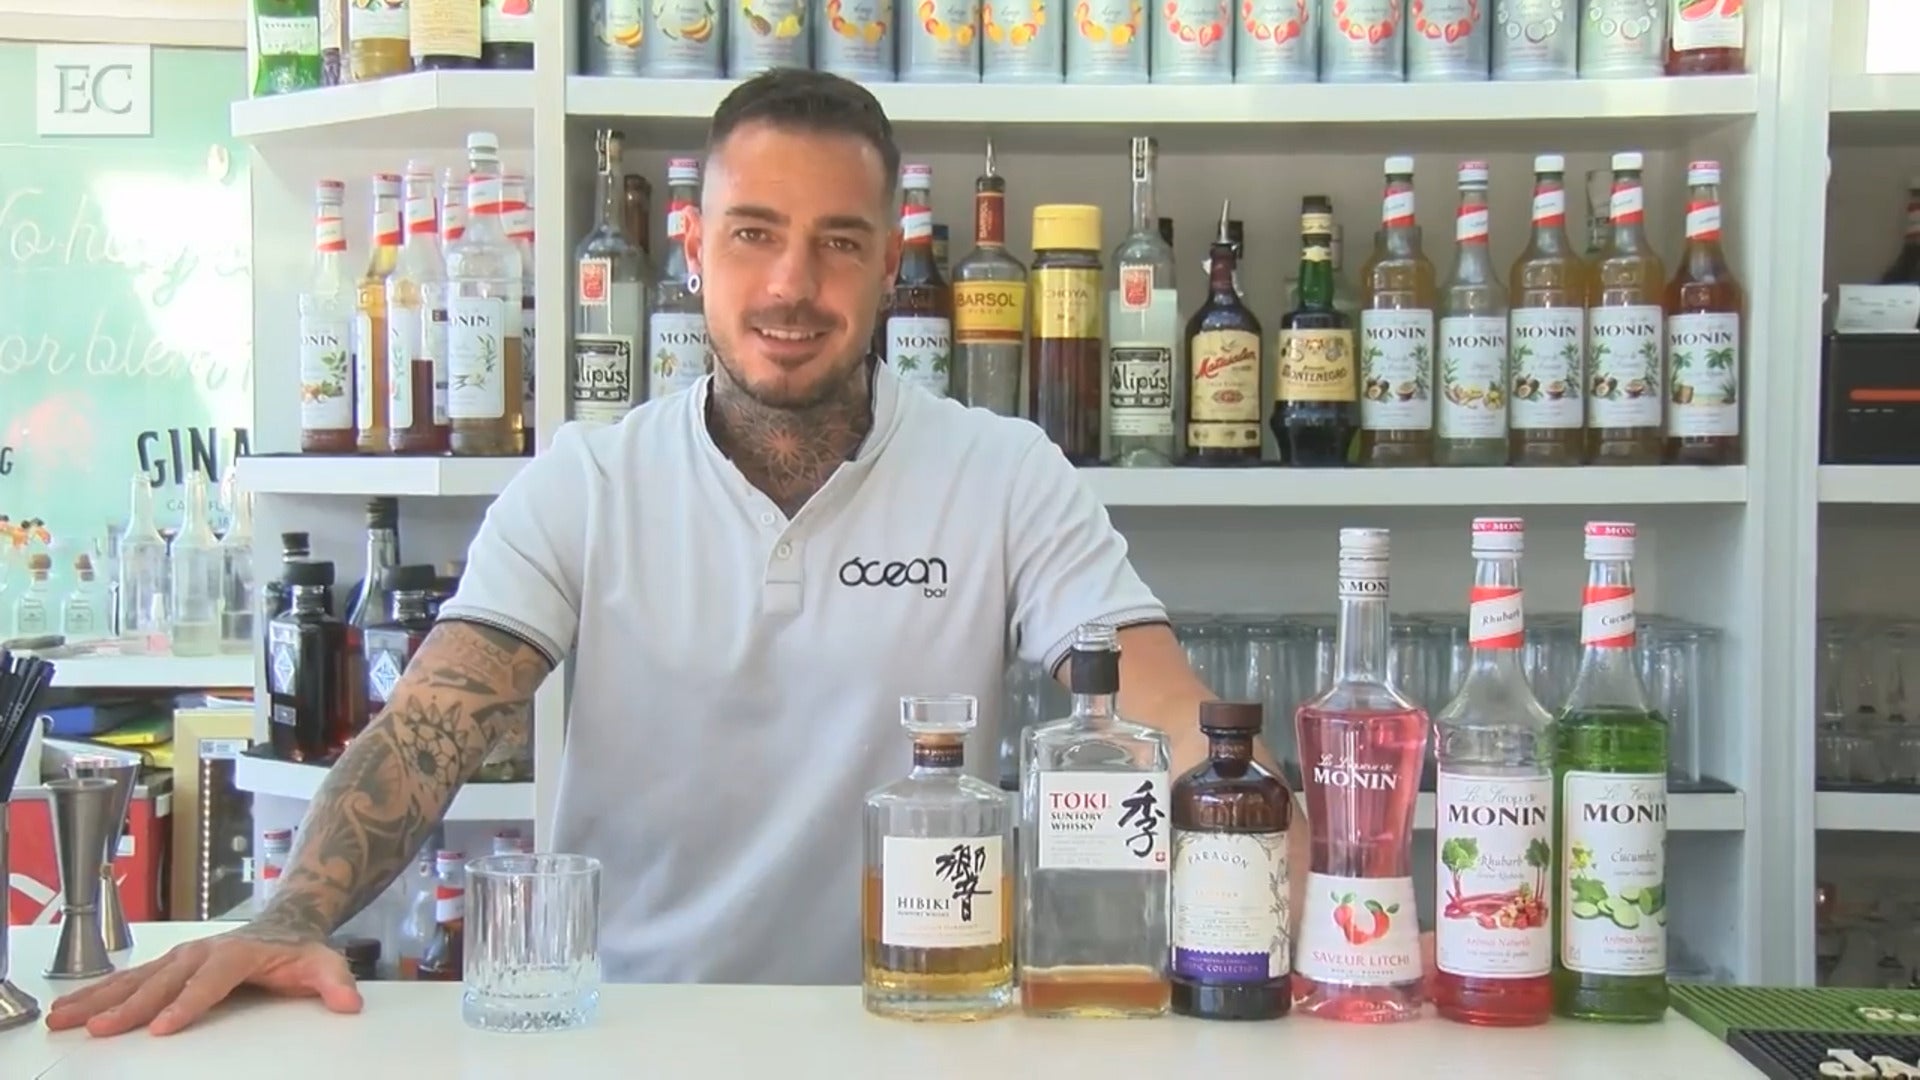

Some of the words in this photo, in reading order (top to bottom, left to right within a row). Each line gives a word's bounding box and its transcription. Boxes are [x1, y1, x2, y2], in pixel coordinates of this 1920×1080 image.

[956, 292, 1017, 307] BARSOL
[1366, 327, 1427, 340] MONIN
[1516, 326, 1576, 338] MONIN
[1593, 324, 1656, 336] MONIN
[1670, 332, 1733, 346] MONIN
[137, 427, 219, 488] GIN
[923, 587, 947, 598] bar
[1482, 608, 1520, 626] Rhubarb
[1313, 767, 1398, 790] MONIN
[1049, 792, 1107, 809] TOKI
[1051, 811, 1102, 821] SUNTORY
[1118, 780, 1166, 858] 季
[1448, 804, 1547, 826] MONIN
[1051, 822, 1095, 831] WHISKY
[1188, 851, 1249, 869] PARAGON
[935, 844, 993, 921] 響
[897, 896, 950, 910] HIBIKI
[1311, 950, 1365, 966] SAVEUR
[1370, 954, 1410, 966] LITCHI
